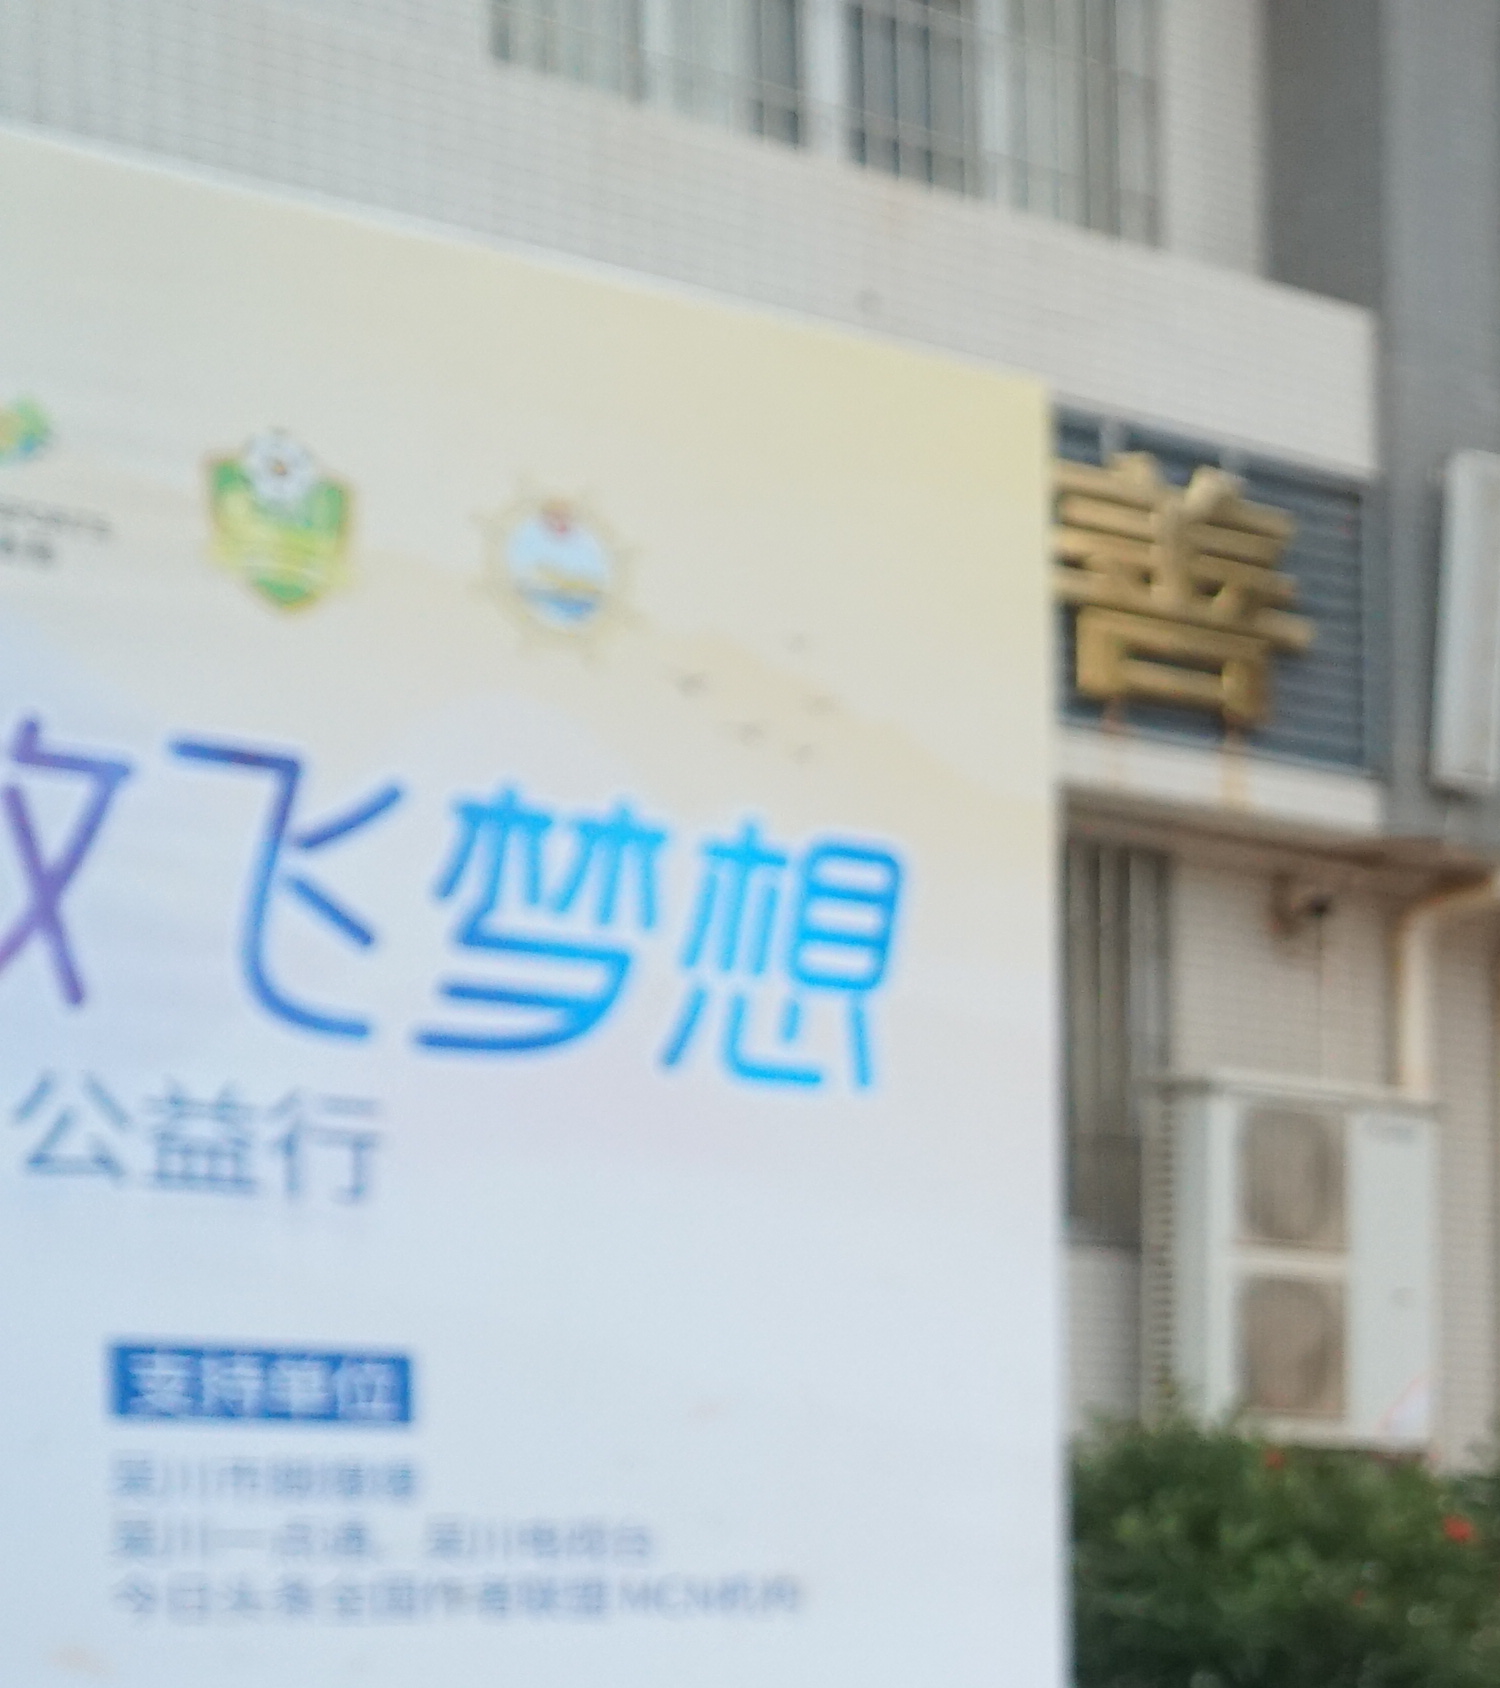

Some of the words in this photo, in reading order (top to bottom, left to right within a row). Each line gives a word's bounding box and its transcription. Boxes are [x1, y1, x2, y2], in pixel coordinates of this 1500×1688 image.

[1053, 450, 1314, 728] 善
[12, 1070, 388, 1203] 公益行
[128, 1352, 398, 1418] 支持单位
